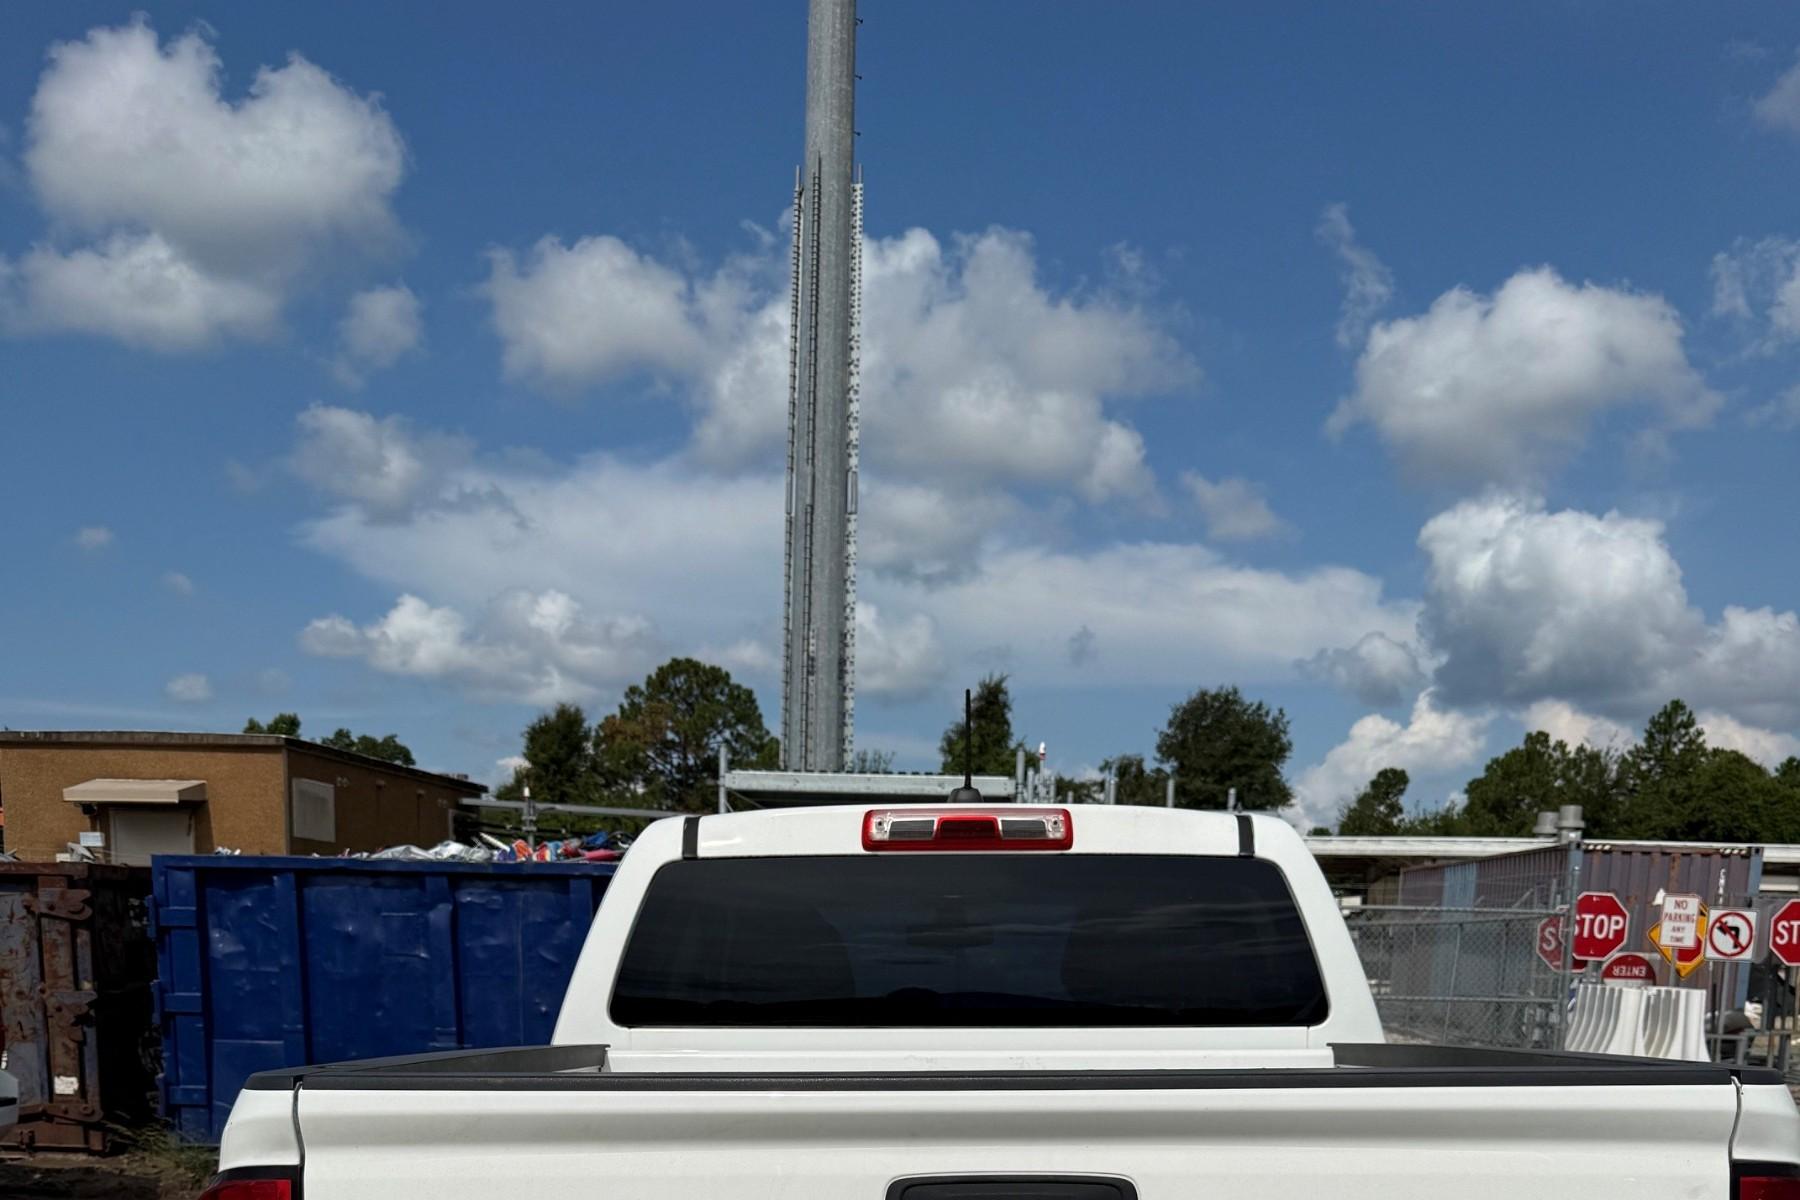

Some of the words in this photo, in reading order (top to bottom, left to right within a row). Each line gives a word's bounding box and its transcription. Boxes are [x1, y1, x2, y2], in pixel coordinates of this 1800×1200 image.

[1673, 899, 1688, 910] NO
[1664, 912, 1695, 923] PARKING
[1671, 925, 1686, 933] ANY
[1670, 935, 1685, 943] TIME
[1612, 965, 1647, 977] ENTER
